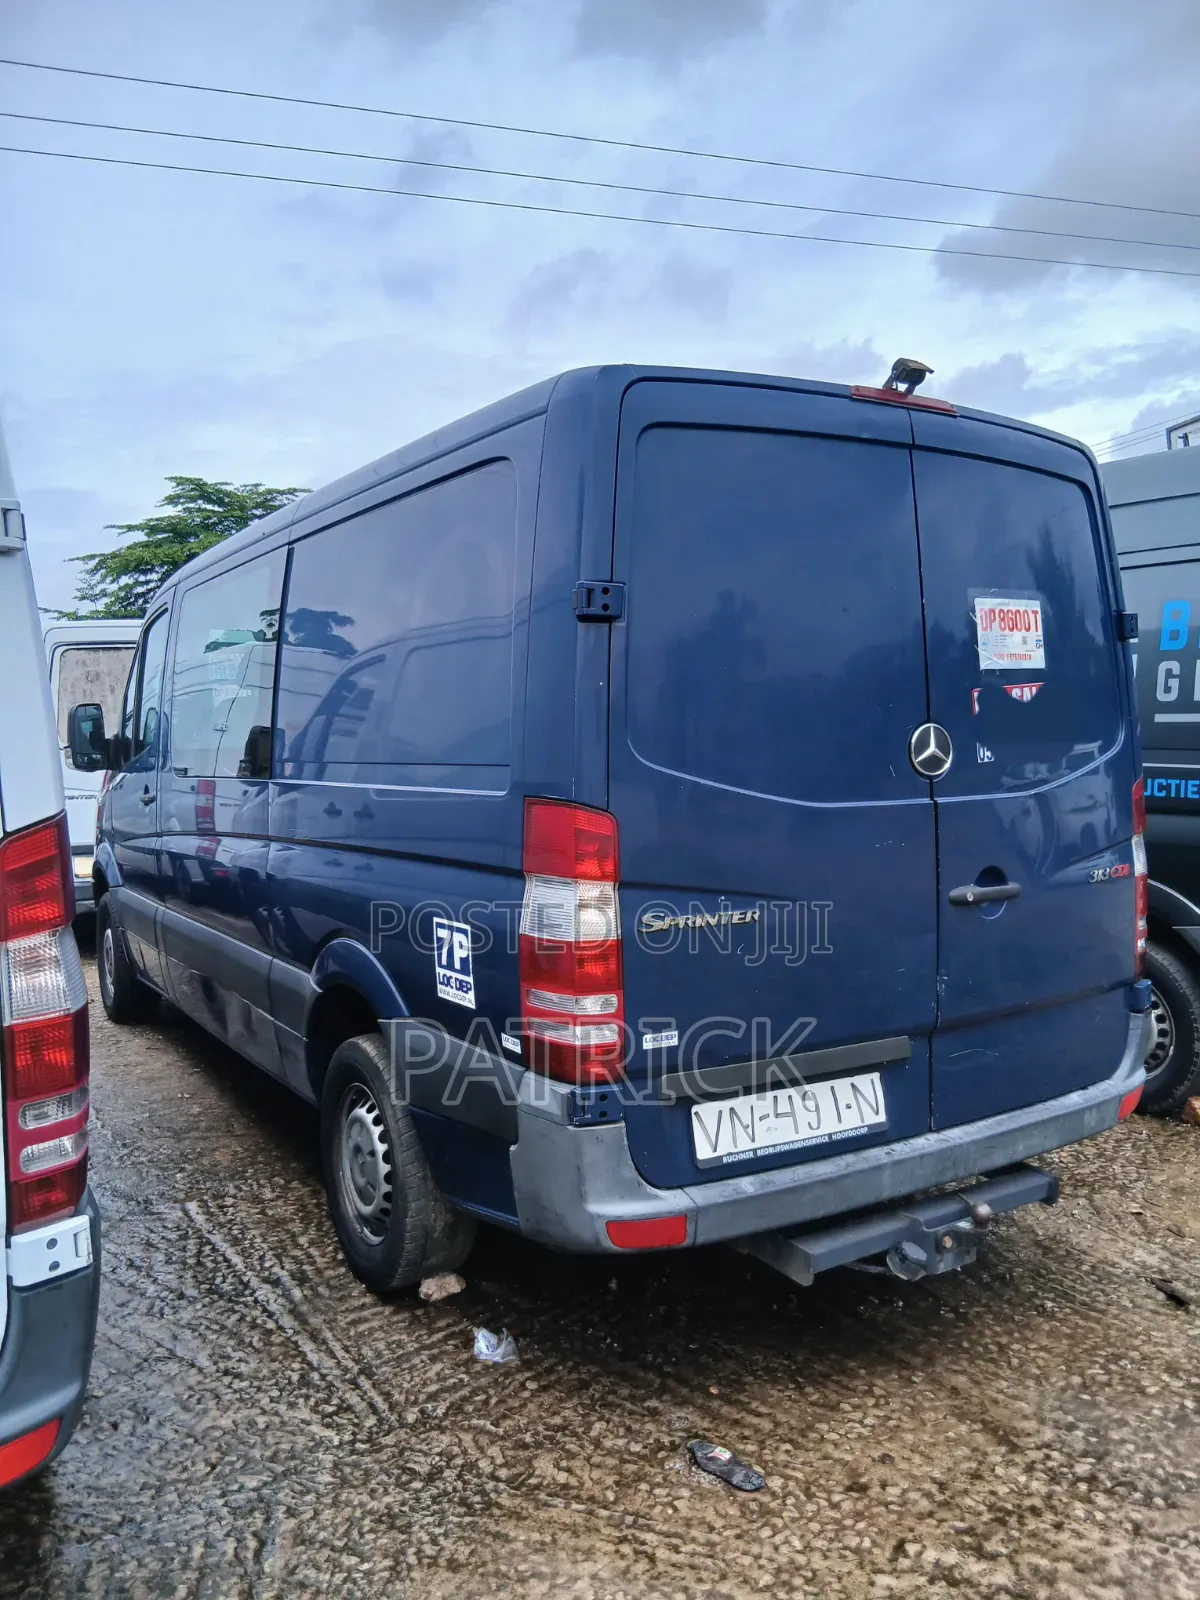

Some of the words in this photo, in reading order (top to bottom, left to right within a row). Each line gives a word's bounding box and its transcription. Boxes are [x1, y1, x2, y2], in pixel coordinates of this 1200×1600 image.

[997, 608, 1031, 633] 8600
[1032, 610, 1039, 633] T
[1159, 600, 1200, 651] B
[1089, 867, 1110, 883] 313
[1110, 863, 1130, 878] CDI
[637, 909, 760, 933] SPRINTER
[437, 927, 469, 971] 7P
[722, 1151, 754, 1164] BUCHNER
[756, 1135, 829, 1156] BEDRIJFSWAGENSERVICE
[831, 1126, 868, 1141] HOOFDDORP
